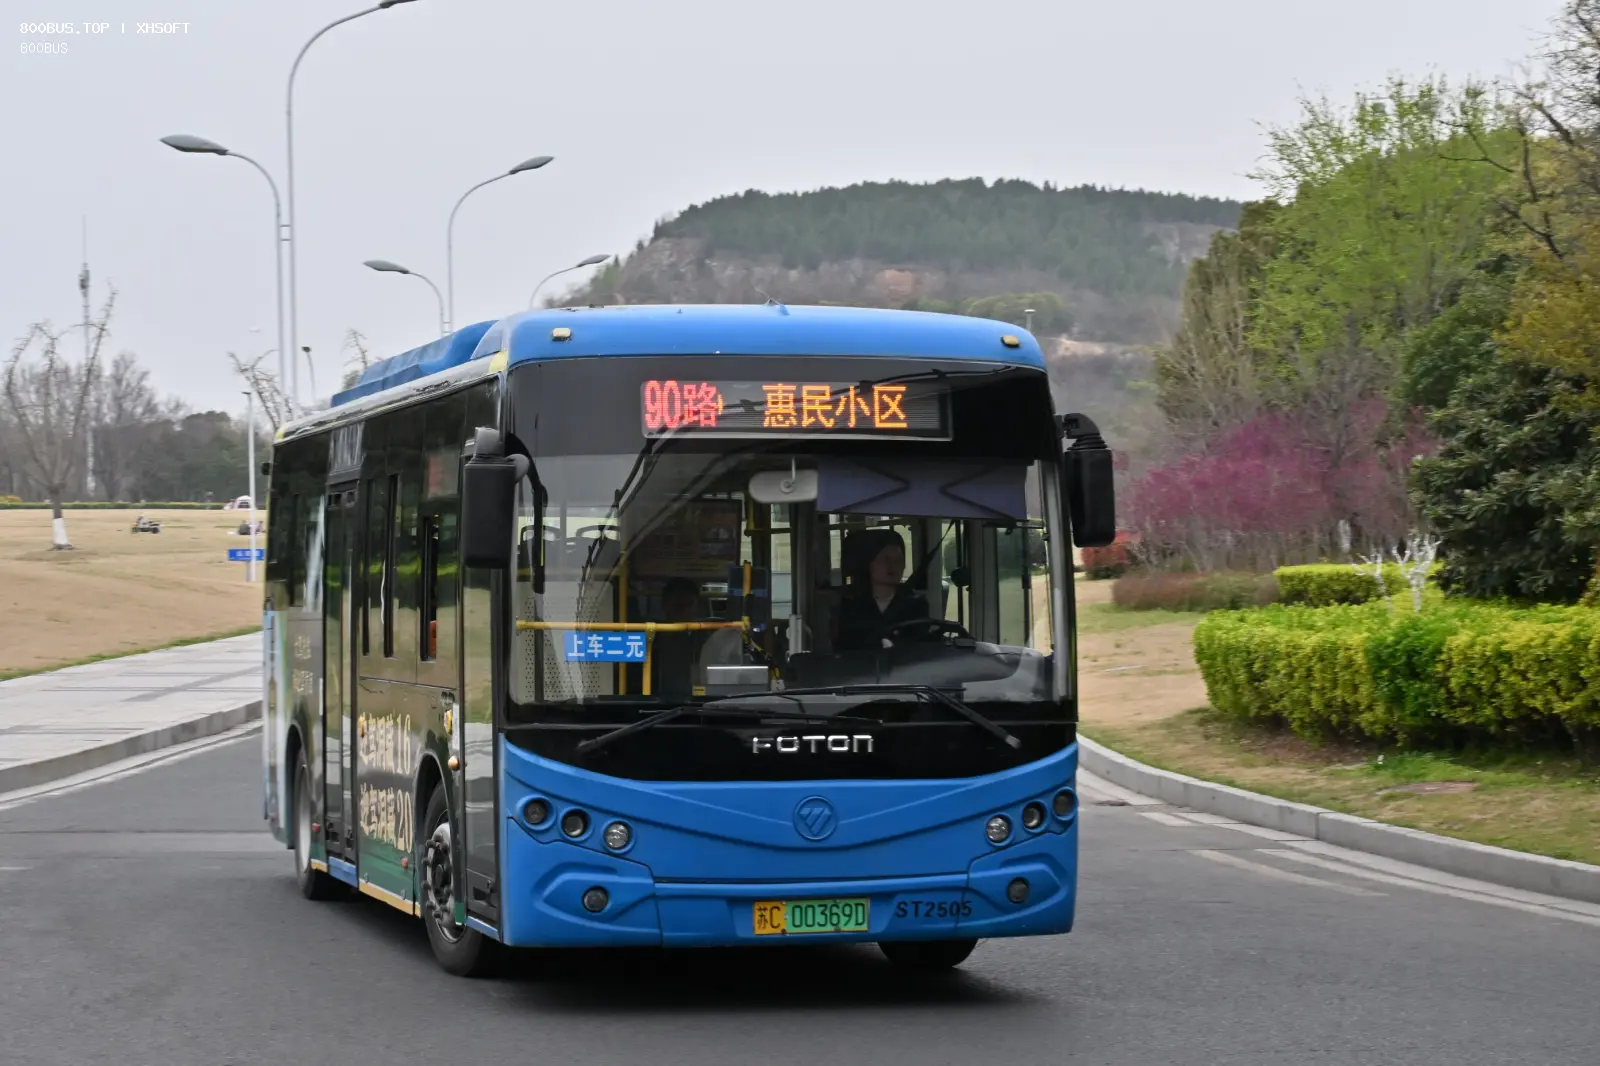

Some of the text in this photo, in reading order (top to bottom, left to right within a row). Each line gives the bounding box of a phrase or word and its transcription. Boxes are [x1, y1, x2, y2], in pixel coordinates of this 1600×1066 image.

[644, 379, 908, 429] 90路 惠民小区
[567, 633, 644, 658] 上车二元
[752, 734, 874, 754] FOTON
[791, 902, 866, 929] 00369D
[894, 899, 973, 919] ST2505
